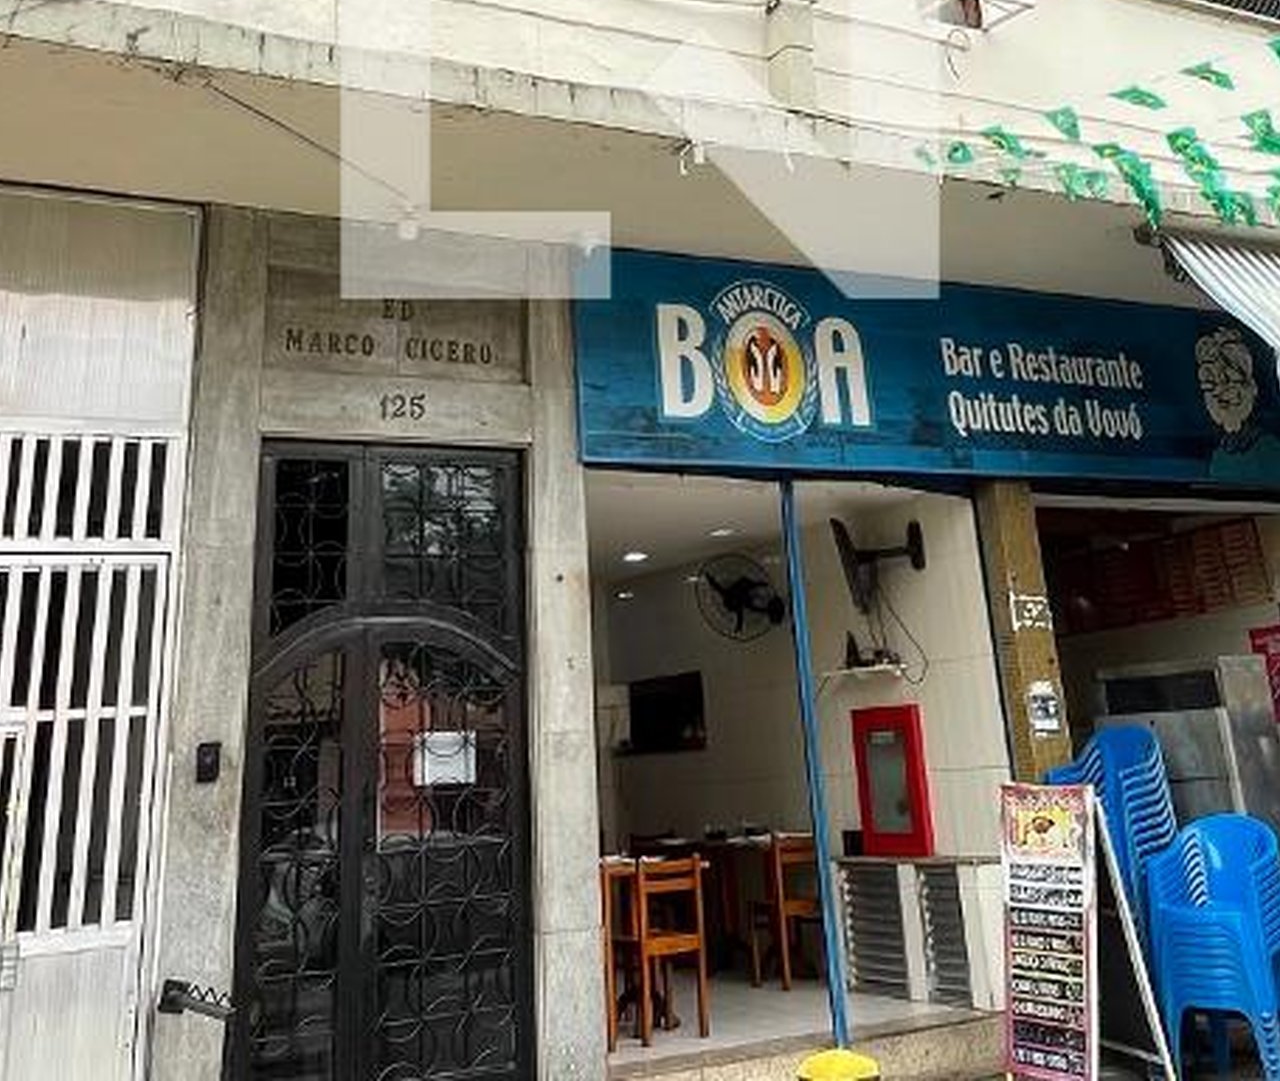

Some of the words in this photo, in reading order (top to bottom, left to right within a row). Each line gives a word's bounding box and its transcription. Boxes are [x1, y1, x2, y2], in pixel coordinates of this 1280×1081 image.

[381, 299, 415, 320] ED
[716, 285, 803, 329] ANTARCTICA
[285, 328, 376, 357] MARCO
[405, 336, 493, 365] CICERO
[940, 337, 982, 377] Bar
[989, 349, 1004, 378] e
[1007, 342, 1144, 389] Restaurante
[379, 393, 426, 420] 125
[948, 390, 1049, 437] Quitutes
[1053, 398, 1083, 436] da
